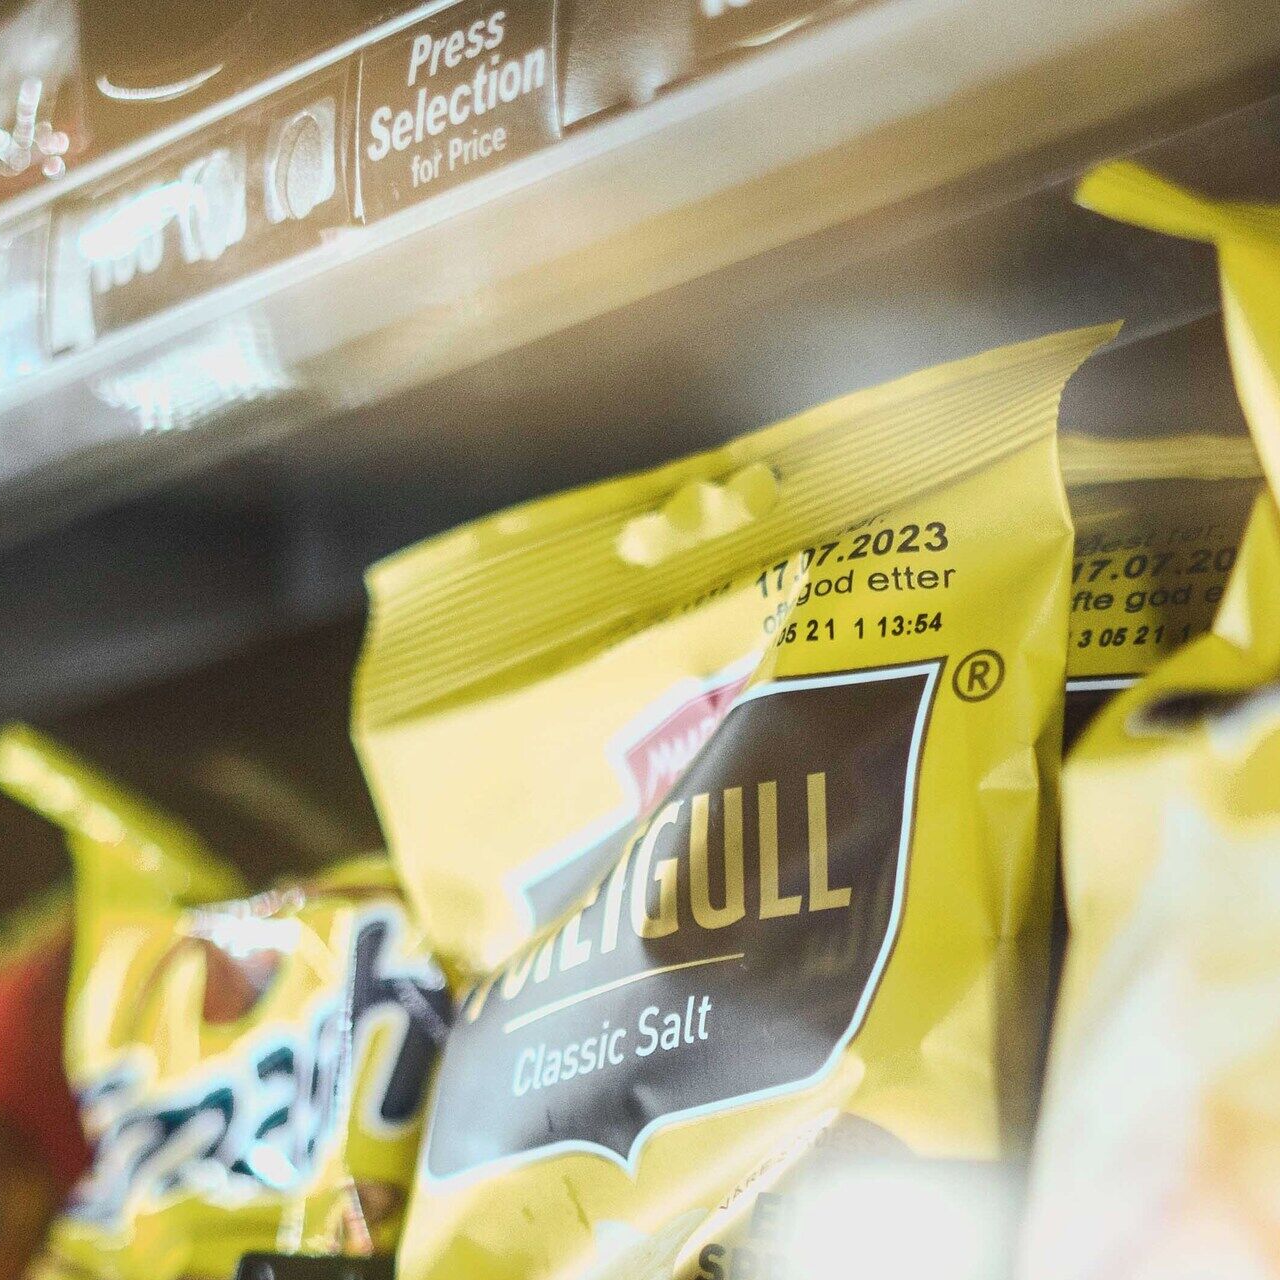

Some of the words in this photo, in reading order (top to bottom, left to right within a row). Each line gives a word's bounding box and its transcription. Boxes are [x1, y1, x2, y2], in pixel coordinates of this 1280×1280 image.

[407, 10, 506, 87] Press
[368, 47, 545, 162] Selection
[411, 149, 442, 188] for
[449, 127, 507, 171] Price
[796, 569, 855, 606] god
[867, 566, 957, 592] etter
[1071, 547, 1237, 584] 17.07.20
[1071, 588, 1114, 613] fte
[806, 618, 835, 642] 21
[877, 611, 943, 638] 13:54
[513, 1020, 627, 1097] Classic
[635, 995, 712, 1058] Salt
